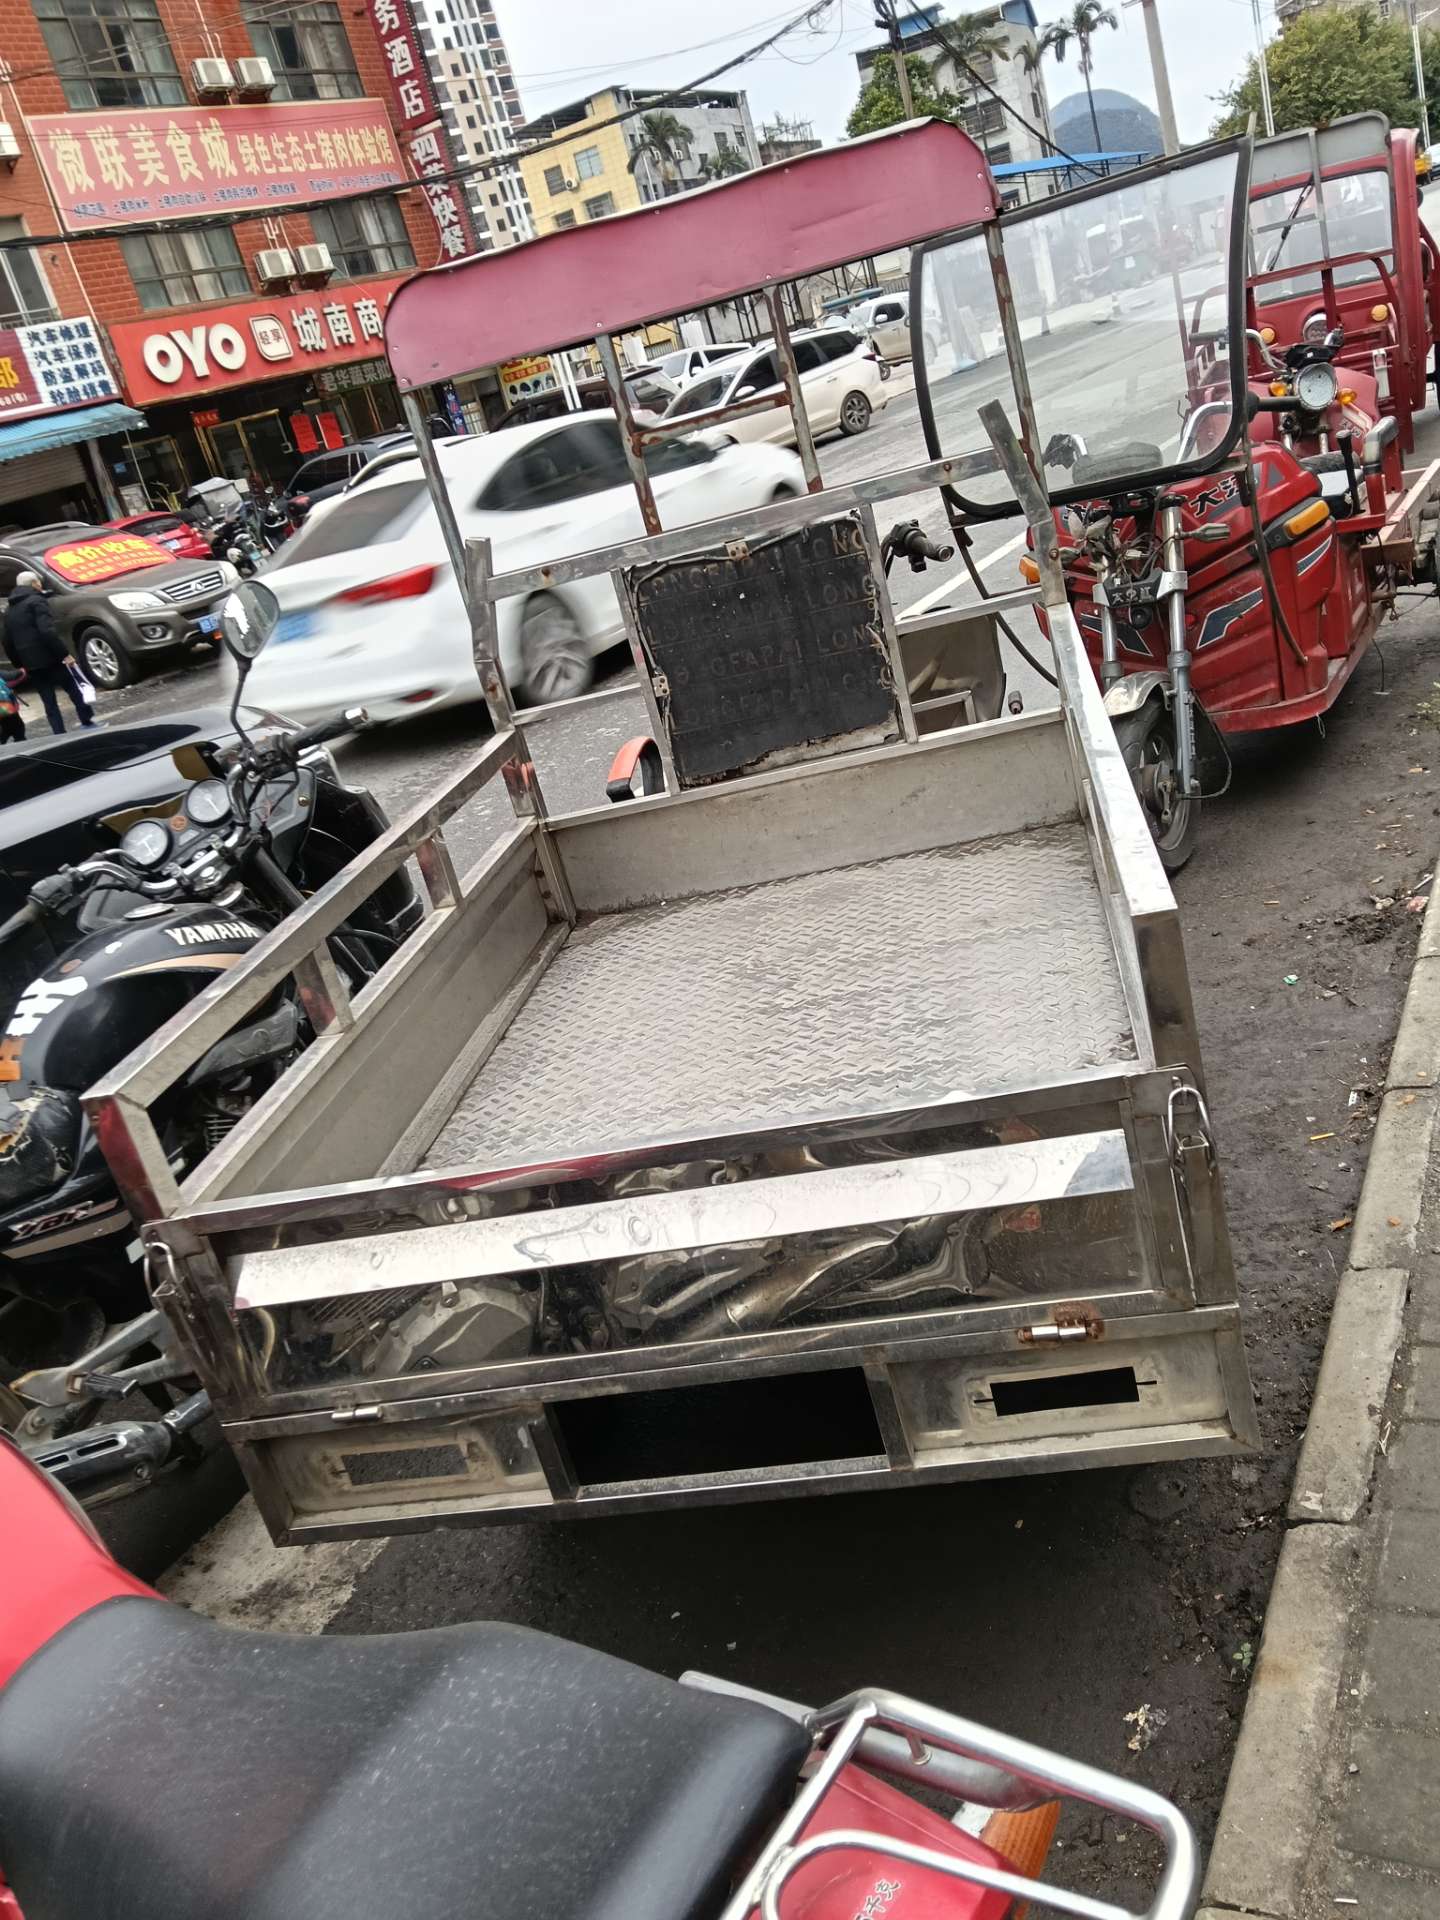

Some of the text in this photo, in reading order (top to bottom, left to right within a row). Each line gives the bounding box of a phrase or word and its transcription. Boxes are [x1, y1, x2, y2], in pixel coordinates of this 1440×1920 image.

[26, 322, 92, 348] 汽车修理
[290, 292, 393, 352] 城南商
[33, 341, 98, 367] 汽车保养
[143, 322, 247, 384] OYO
[41, 359, 107, 387] 防盗解码
[814, 619, 878, 655] LON
[164, 920, 260, 946] YAMAHA
